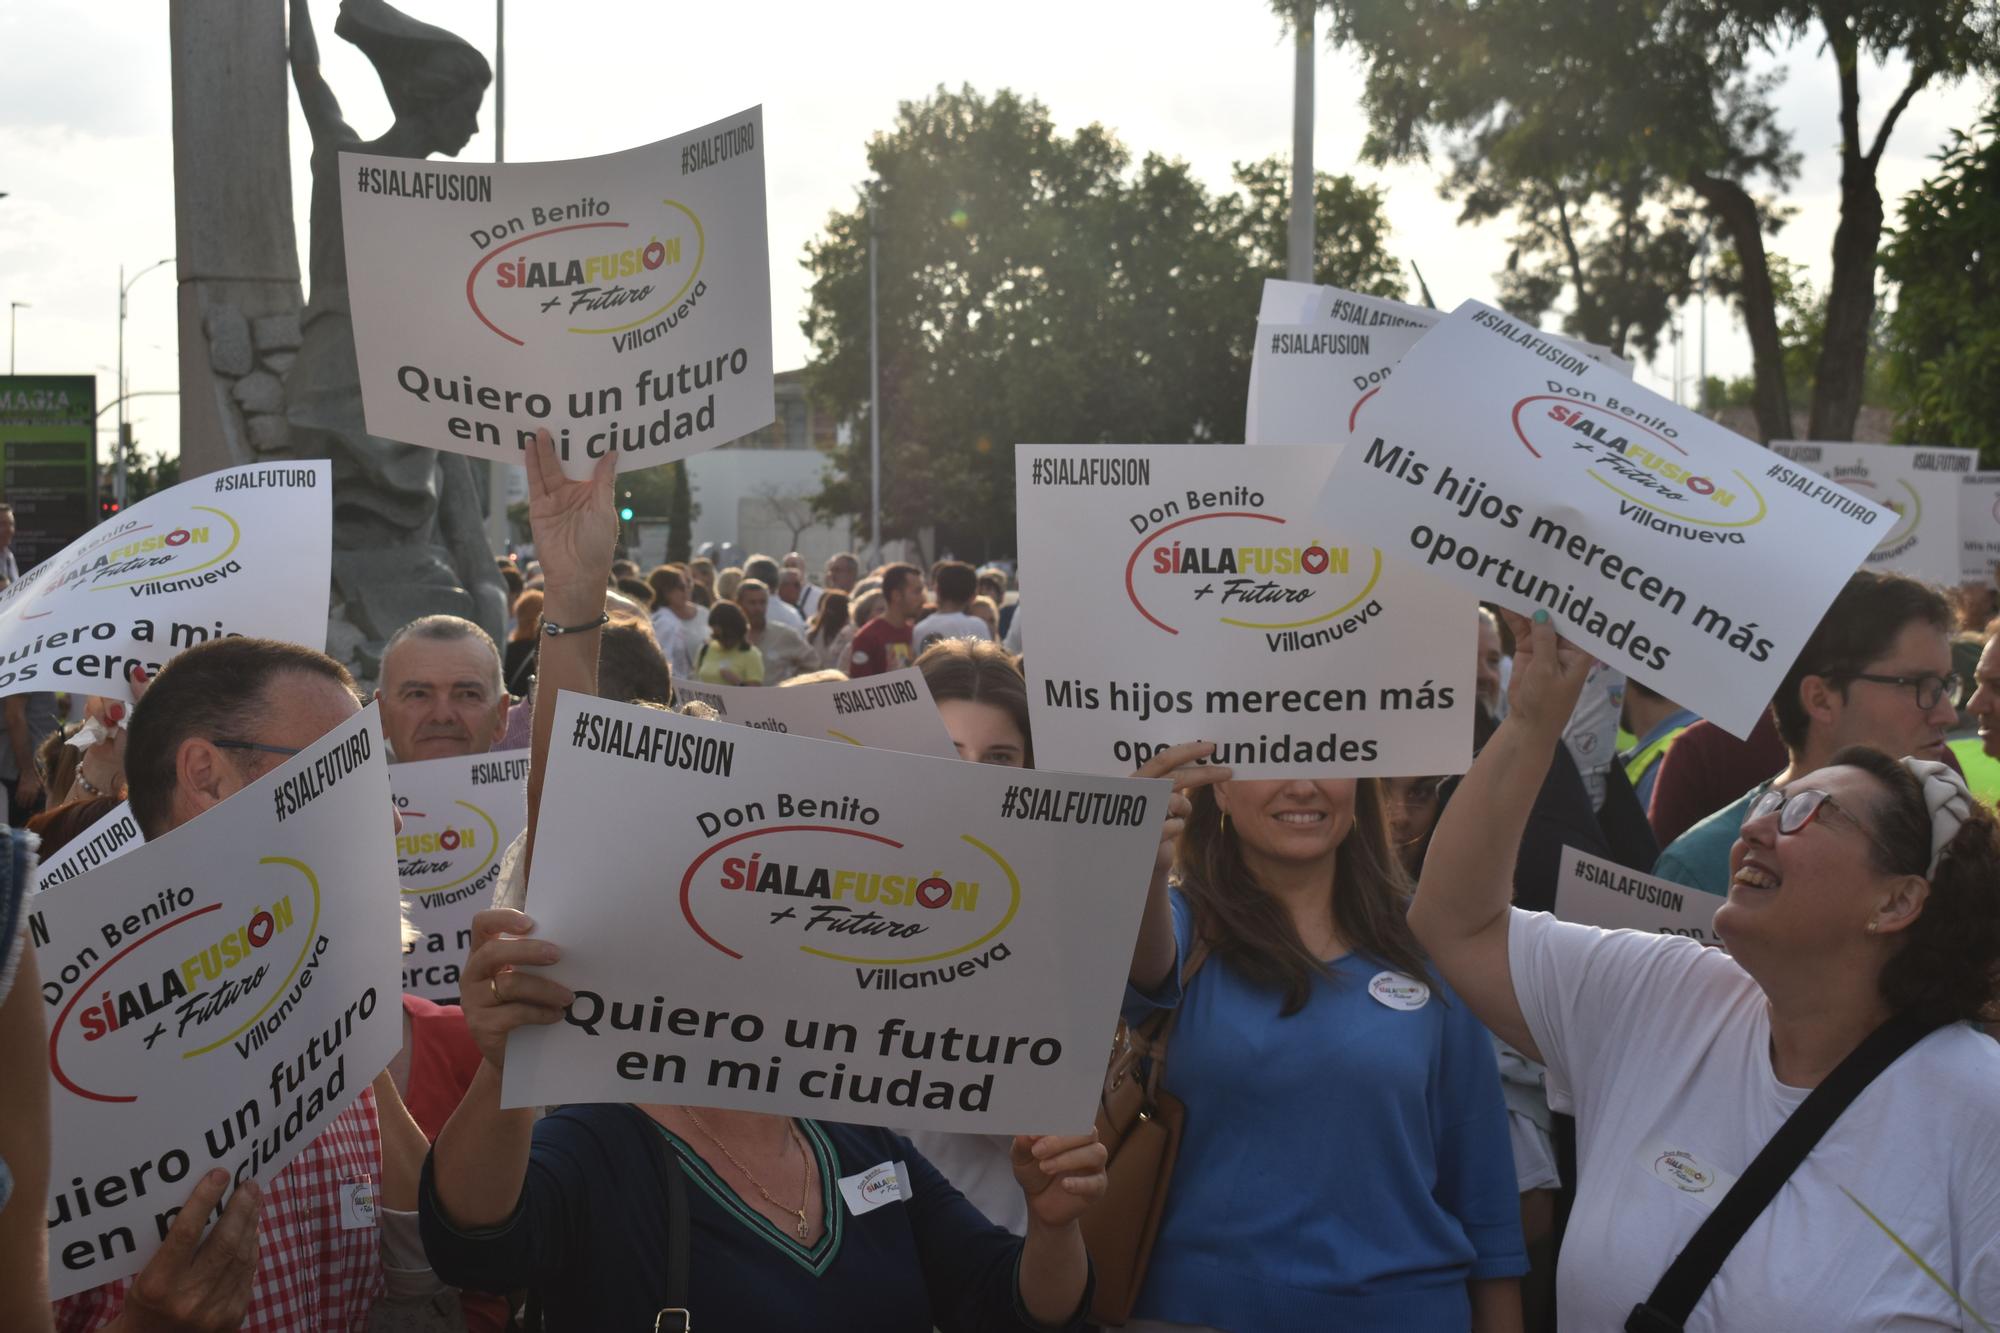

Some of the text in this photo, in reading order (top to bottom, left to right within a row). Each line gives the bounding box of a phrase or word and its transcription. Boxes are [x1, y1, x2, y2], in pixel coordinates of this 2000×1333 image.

[681, 122, 755, 176] #SIALFUTURO
[358, 166, 492, 202] #SIALAFUSION
[470, 197, 611, 250] Don Benito
[568, 284, 655, 315] Futuro
[612, 280, 707, 353] Villanueva
[1272, 333, 1369, 355] #SIALAFUSION
[1472, 309, 1589, 376] #SIALAFUSION
[397, 347, 748, 418] Quiero un futuro
[1353, 366, 1392, 391] Don
[448, 415, 501, 445] en
[587, 394, 715, 459] ciudad
[1547, 380, 1680, 439] Don Benito
[215, 469, 316, 493] #SIALFUTURO
[1032, 458, 1150, 486] #SIALAFUSION
[1596, 450, 1688, 503] Futuro
[1766, 464, 1877, 525] #SIALFUTURO
[1130, 486, 1265, 535] Don Benito
[1619, 500, 1746, 545] Villanueva
[93, 554, 178, 583] Futuro
[1364, 437, 1775, 663] Mis hijos merecen más
[130, 560, 242, 597] Villanueva
[1221, 579, 1316, 605] Futuro
[1410, 525, 1672, 671] oportunidades
[0, 621, 116, 667] uiero
[131, 619, 154, 643] a
[1266, 600, 1383, 653] Villanueva
[833, 680, 918, 715] #SIALFUTURO
[1045, 680, 1455, 721] Mis hijos merecen más
[572, 711, 734, 777] #SIALAFUSION
[1113, 733, 1378, 770] opunidades
[274, 727, 371, 822] #SIALFUTURO
[696, 793, 880, 838] Don Benito
[1000, 784, 1147, 827] #SIALFUTURO
[40, 816, 137, 890] #SIALFUTURO
[1575, 860, 1683, 912] #SIALAFUSION
[42, 947, 99, 1005] Don
[101, 887, 194, 948] Benito
[428, 932, 444, 953] a
[804, 905, 929, 938] Futuro
[855, 942, 1011, 990] Villanueva
[178, 963, 270, 1038] Futuro
[235, 934, 330, 1060] Villanueva
[564, 990, 1062, 1065] Quiero un futuro
[616, 1049, 994, 1112] en mi ciudad
[48, 1149, 190, 1229] uiero
[204, 1099, 261, 1159] un
[270, 987, 377, 1107] futuro
[61, 1224, 136, 1270] en
